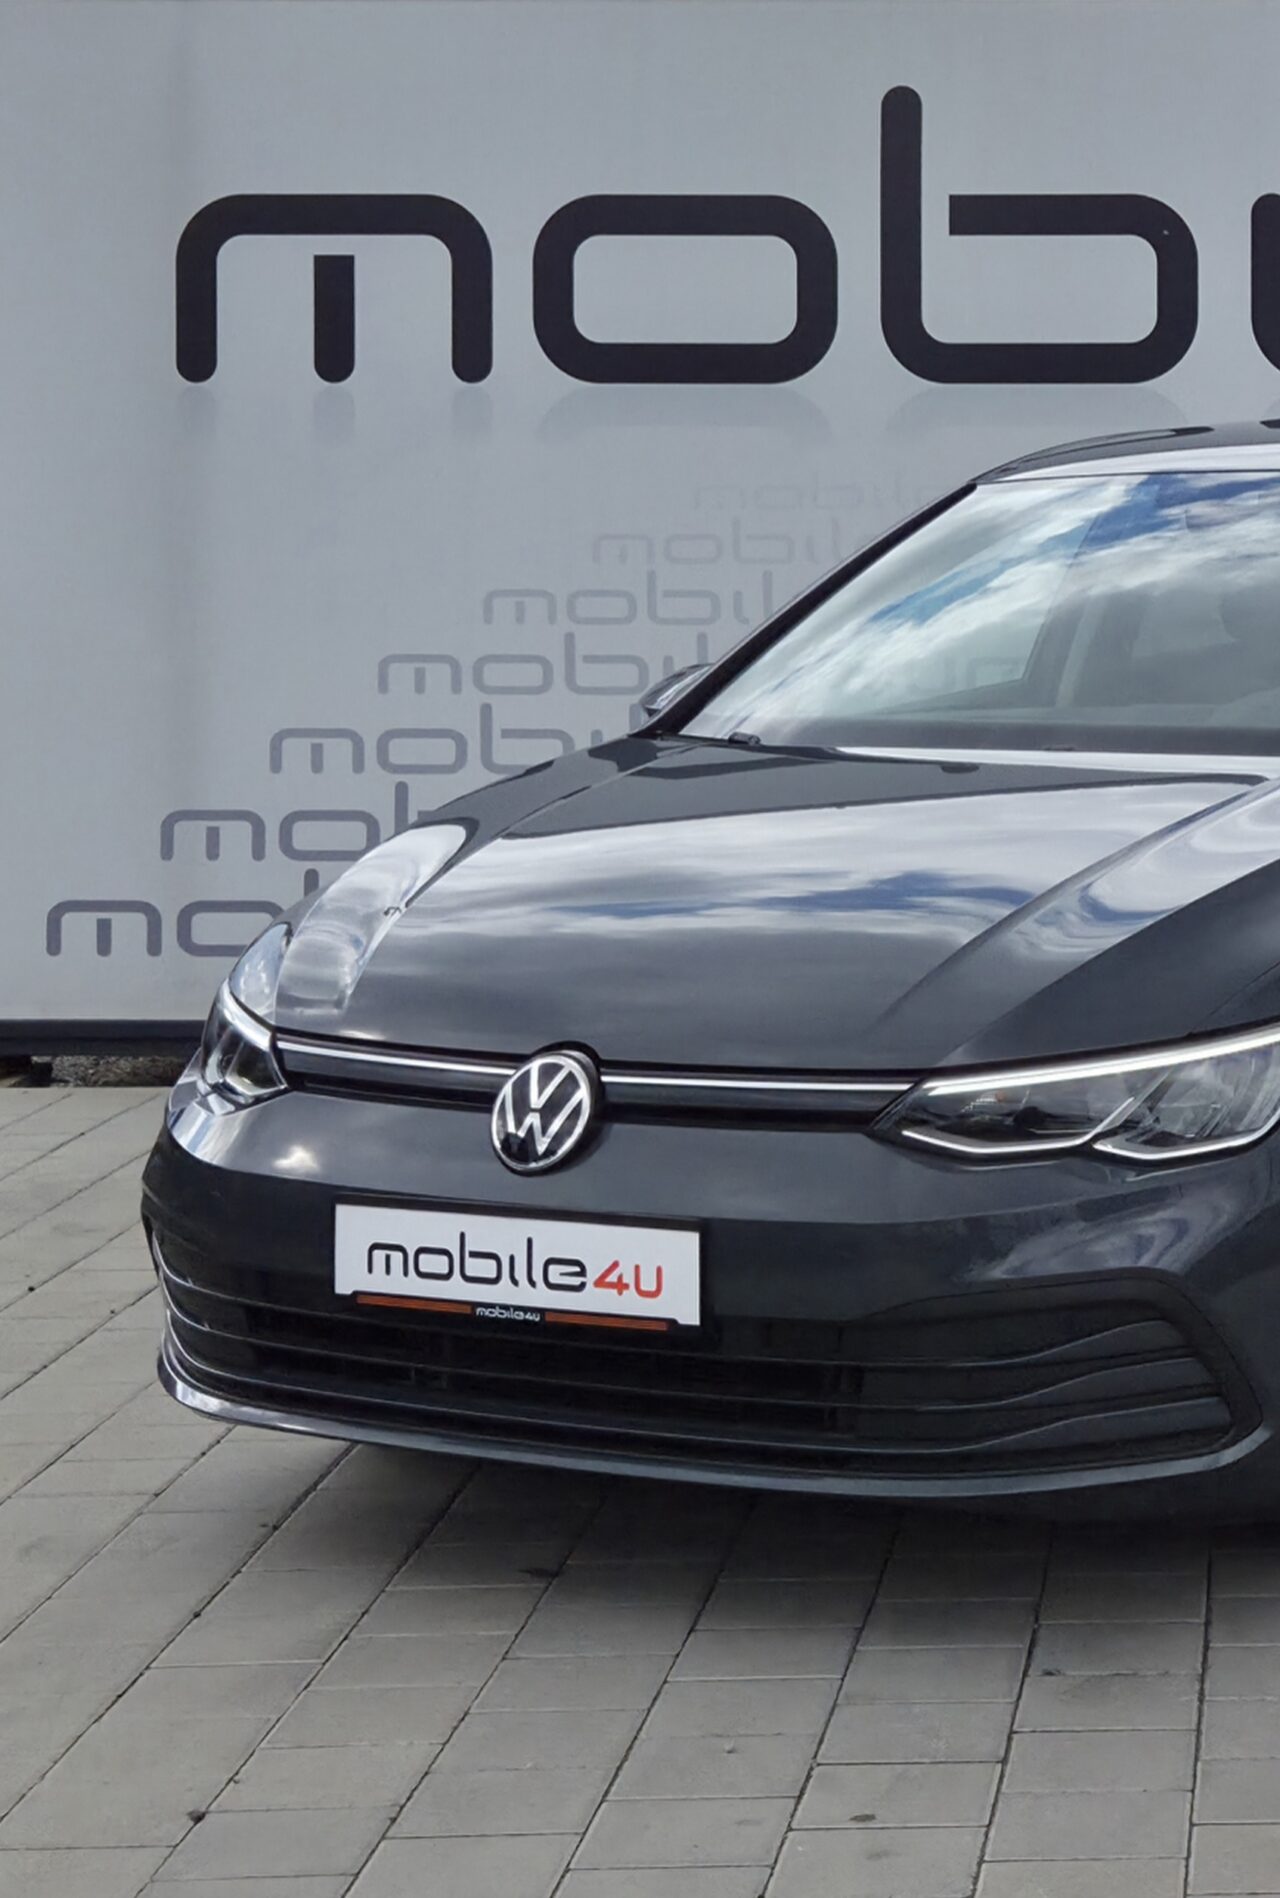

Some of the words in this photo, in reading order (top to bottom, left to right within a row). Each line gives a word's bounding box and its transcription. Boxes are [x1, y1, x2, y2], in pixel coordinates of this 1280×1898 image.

[592, 516, 880, 564] mobil
[160, 781, 436, 861] mo
[46, 868, 320, 957] mo
[367, 1231, 663, 1299] mobile4u
